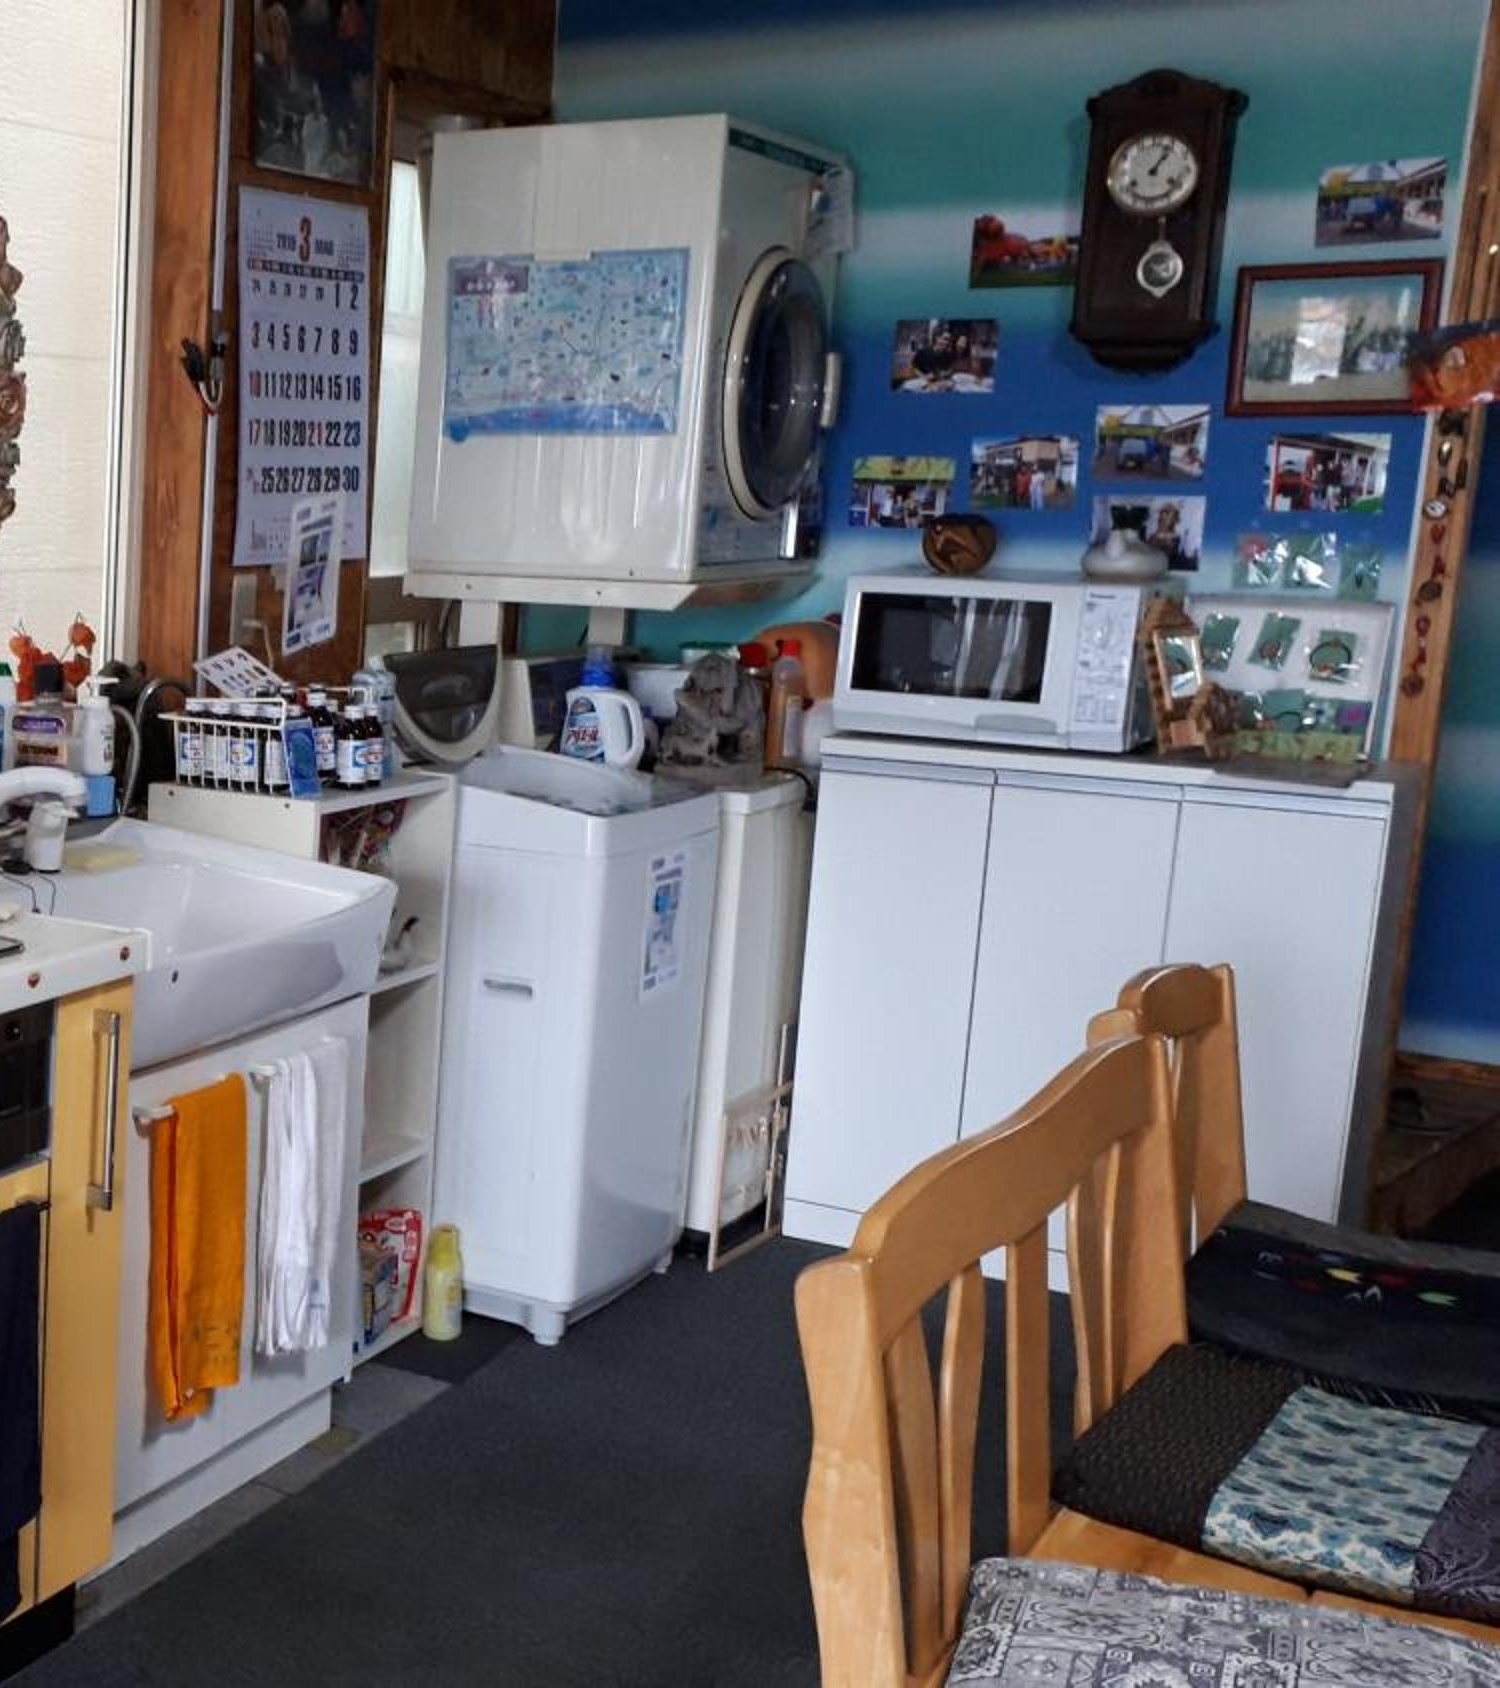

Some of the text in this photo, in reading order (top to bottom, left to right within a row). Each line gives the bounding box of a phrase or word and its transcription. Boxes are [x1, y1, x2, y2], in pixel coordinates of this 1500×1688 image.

[299, 216, 311, 262] 3
[335, 282, 340, 309] 1
[350, 284, 359, 310] 2
[252, 321, 358, 355] 3 4 5 6 7 8 9
[249, 370, 361, 402] 10 11 12 13 14 15 16
[249, 419, 360, 447] 17 18 19 20 21 22 23
[261, 466, 274, 493] 25
[276, 466, 289, 493] 26
[291, 466, 304, 493] 27
[307, 467, 321, 493] 28
[324, 466, 340, 492] 29
[343, 466, 359, 492] 30
